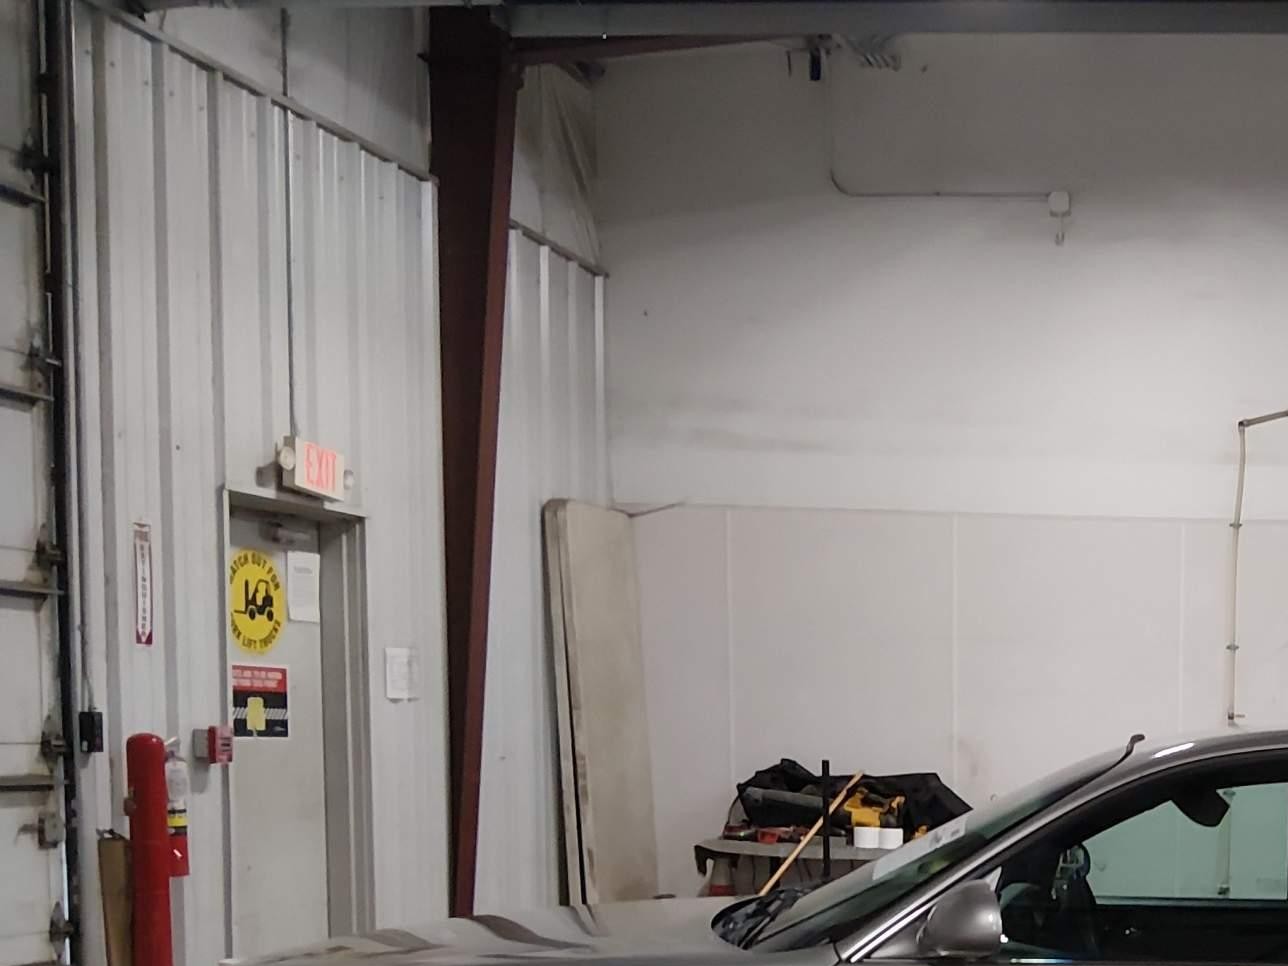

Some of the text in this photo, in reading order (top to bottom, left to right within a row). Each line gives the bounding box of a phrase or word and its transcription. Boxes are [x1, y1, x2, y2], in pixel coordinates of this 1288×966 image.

[304, 443, 336, 493] EXIT
[251, 552, 267, 569] OUT
[266, 566, 280, 592] FOR
